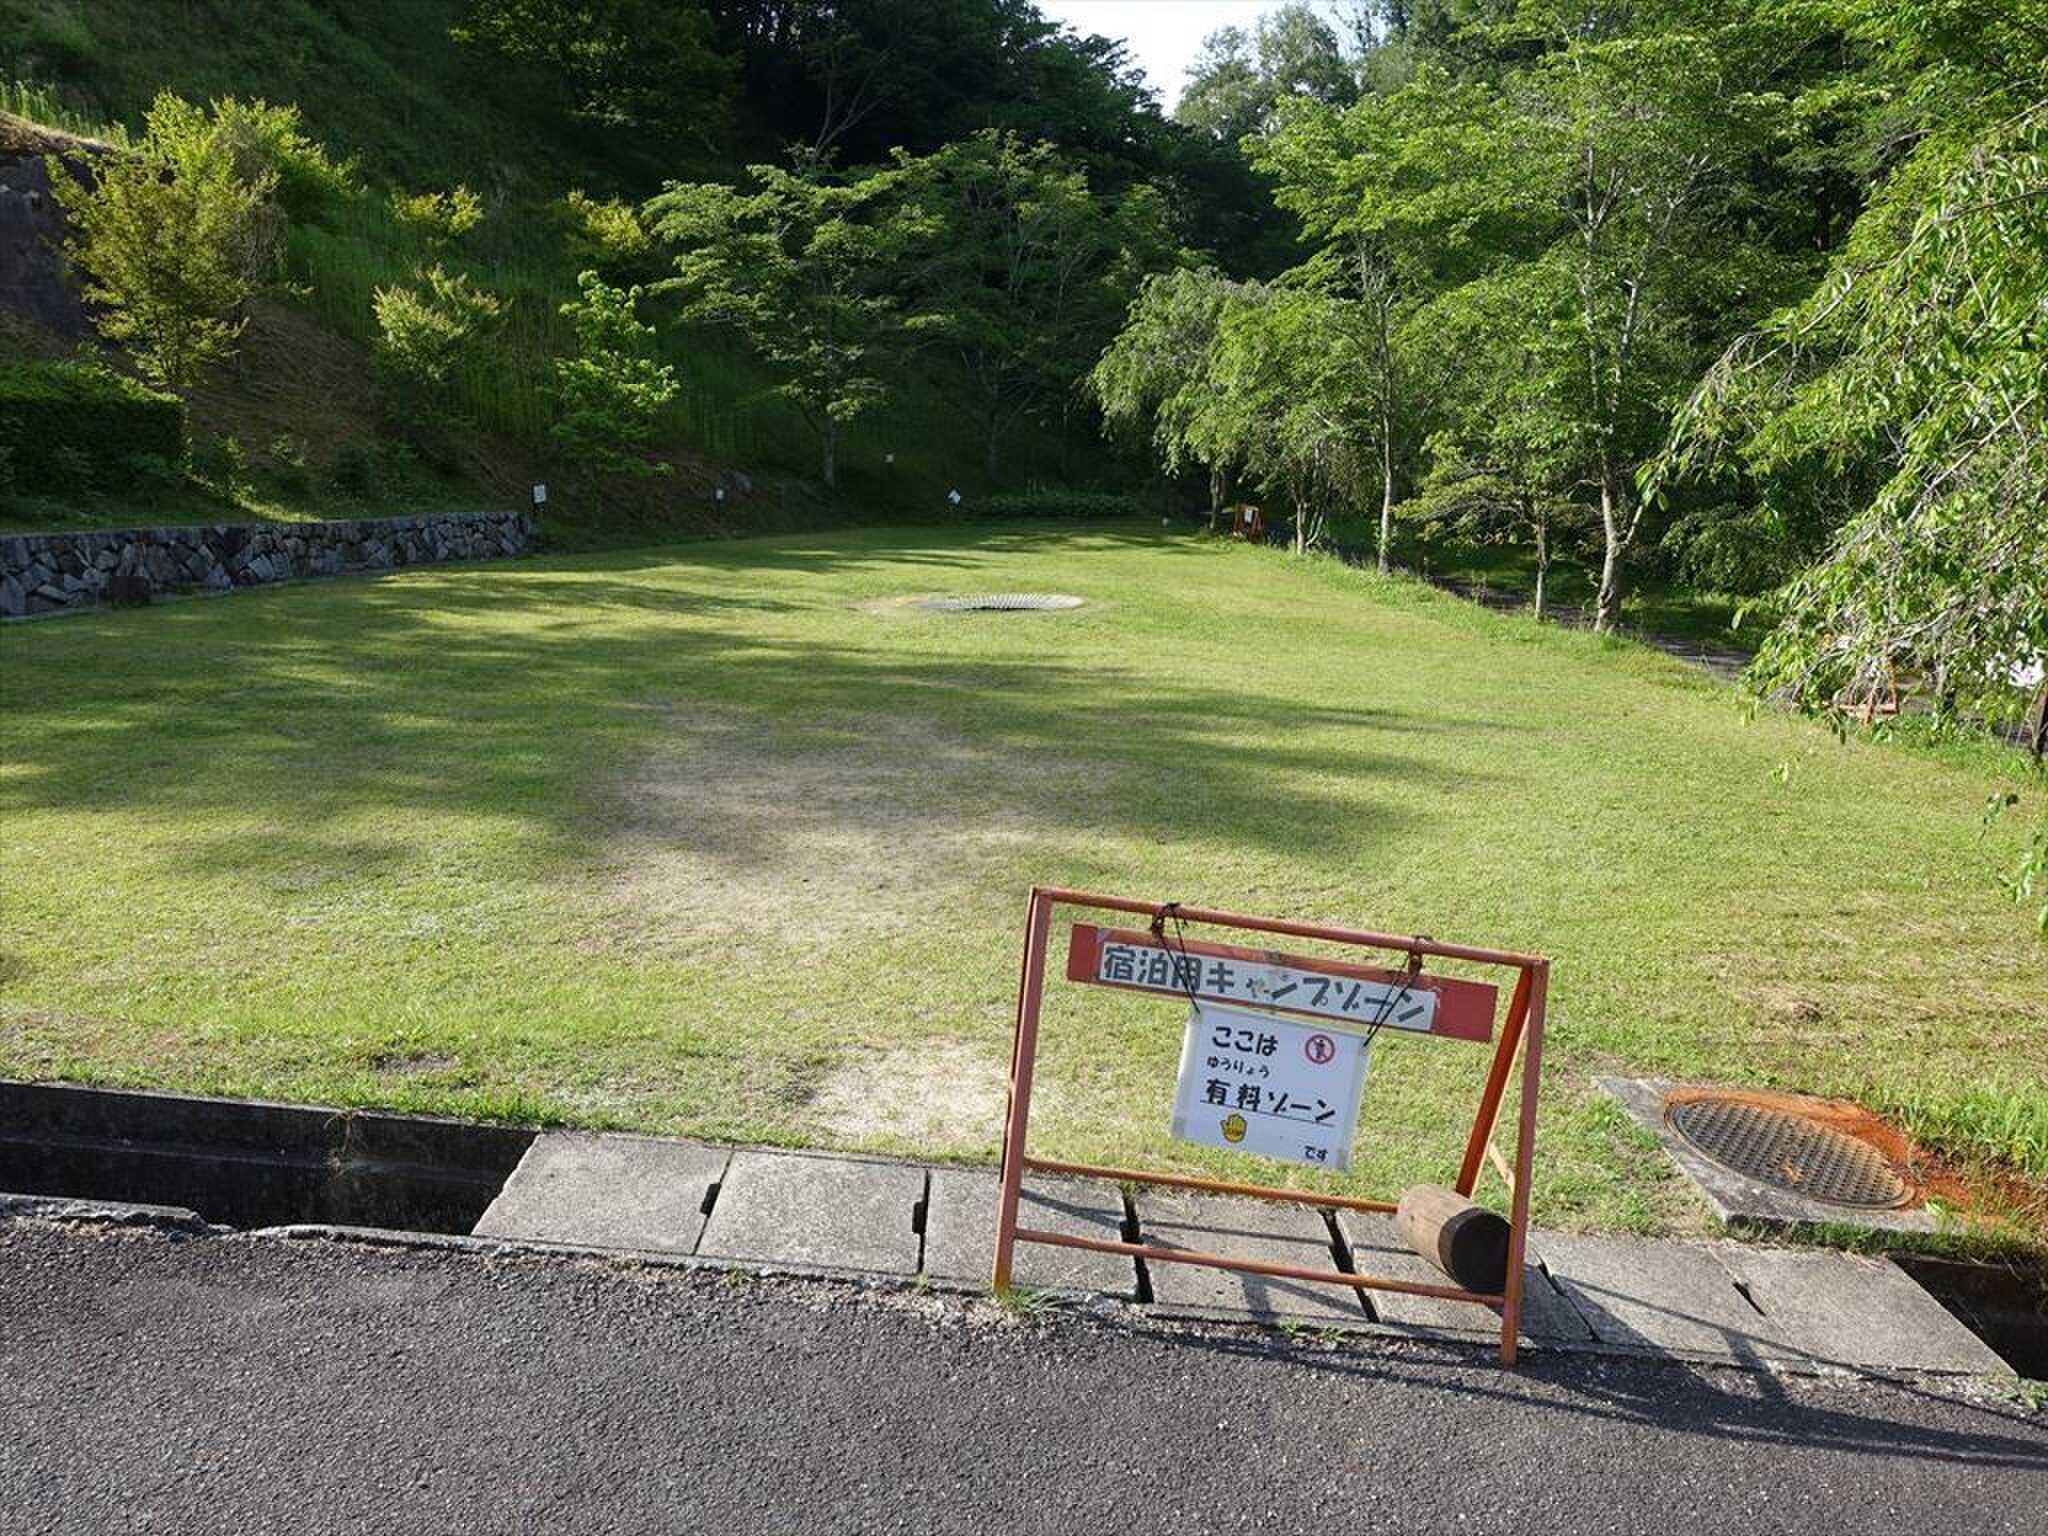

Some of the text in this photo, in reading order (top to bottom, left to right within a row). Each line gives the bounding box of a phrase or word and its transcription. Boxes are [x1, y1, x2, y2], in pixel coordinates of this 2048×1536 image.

[1211, 1026, 1279, 1057] ここは
[1206, 1056, 1271, 1079] ゆうりょう
[1205, 1078, 1337, 1122] 有料ゾーン
[1303, 1145, 1329, 1162] です
